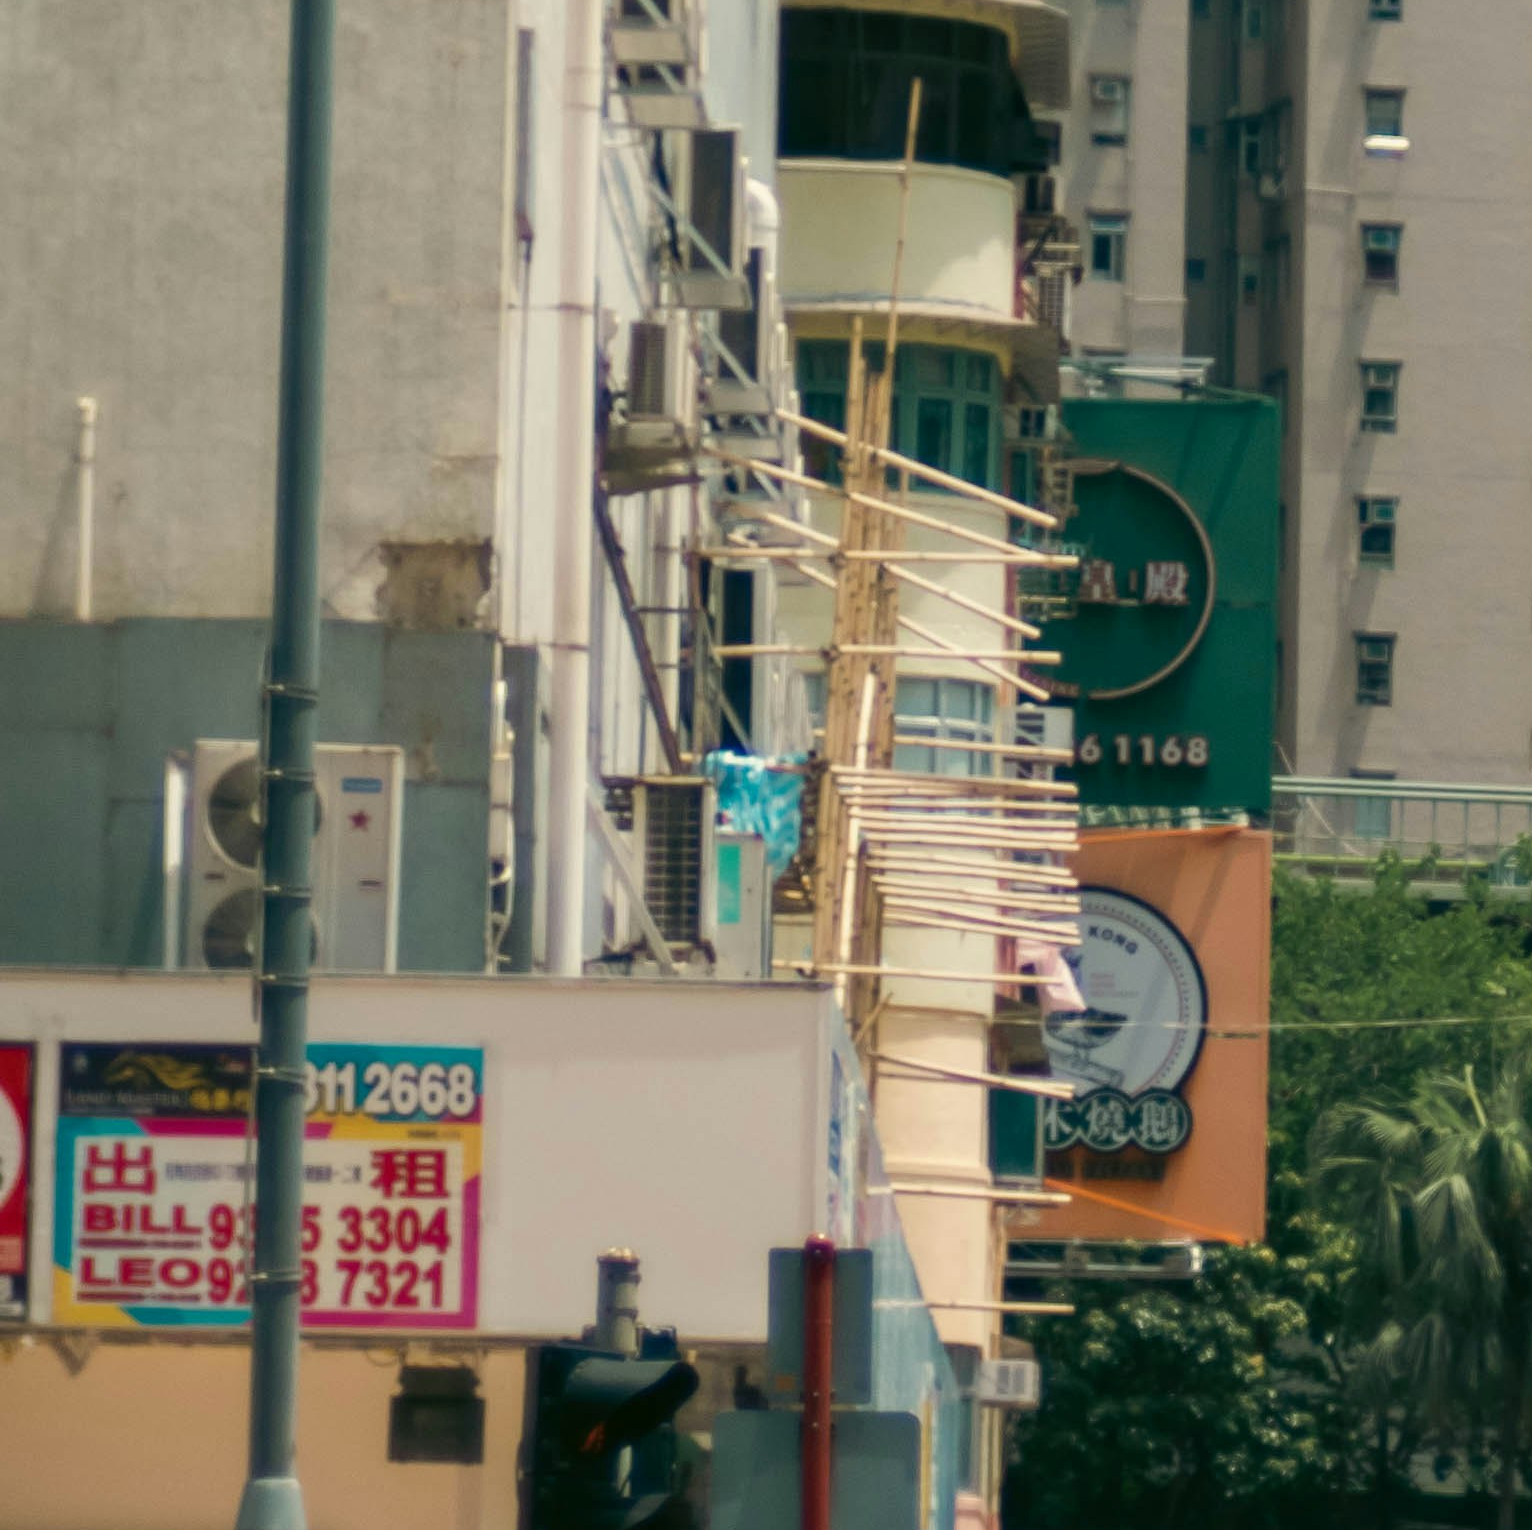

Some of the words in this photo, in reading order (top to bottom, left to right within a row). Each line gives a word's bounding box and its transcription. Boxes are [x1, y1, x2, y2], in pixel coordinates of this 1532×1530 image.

[1116, 735, 1208, 765] 1168
[1088, 925, 1138, 955] KONG
[362, 1061, 477, 1117] 2668
[82, 1142, 156, 1195] 出
[370, 1149, 448, 1199] 租
[82, 1203, 202, 1233] BILL
[209, 1203, 321, 1253] 935
[337, 1206, 449, 1255] 3304
[79, 1256, 201, 1288] LEO
[335, 1259, 444, 1308] 7321
